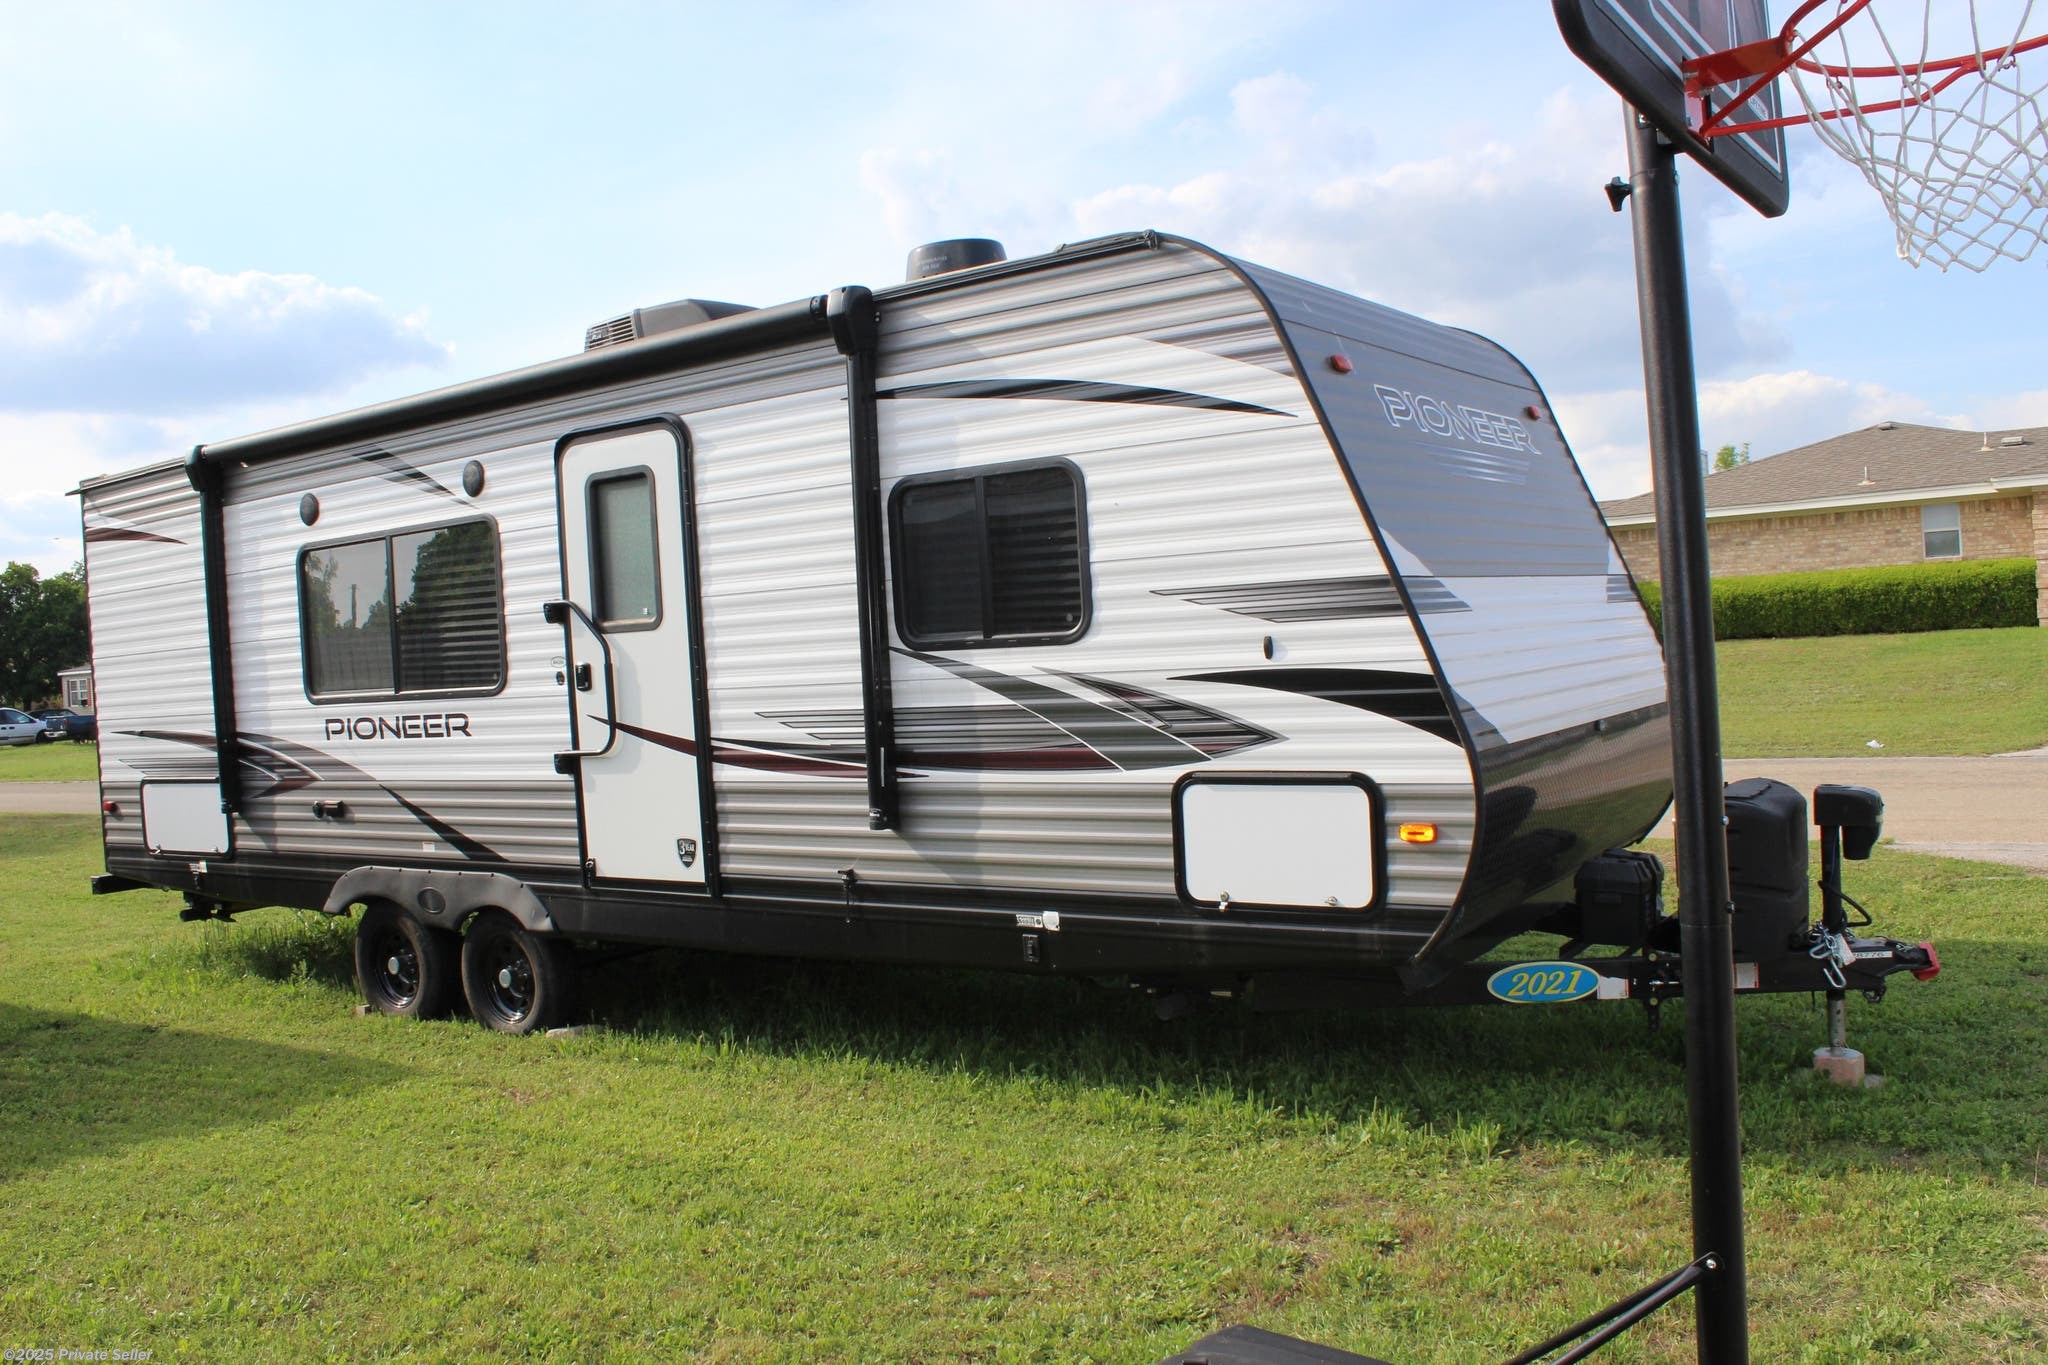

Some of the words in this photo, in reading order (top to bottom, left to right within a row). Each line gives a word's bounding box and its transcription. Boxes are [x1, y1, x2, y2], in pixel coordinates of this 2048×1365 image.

[1373, 384, 1542, 455] PIONEER
[325, 713, 472, 741] PIONEER
[1507, 970, 1582, 996] 2021
